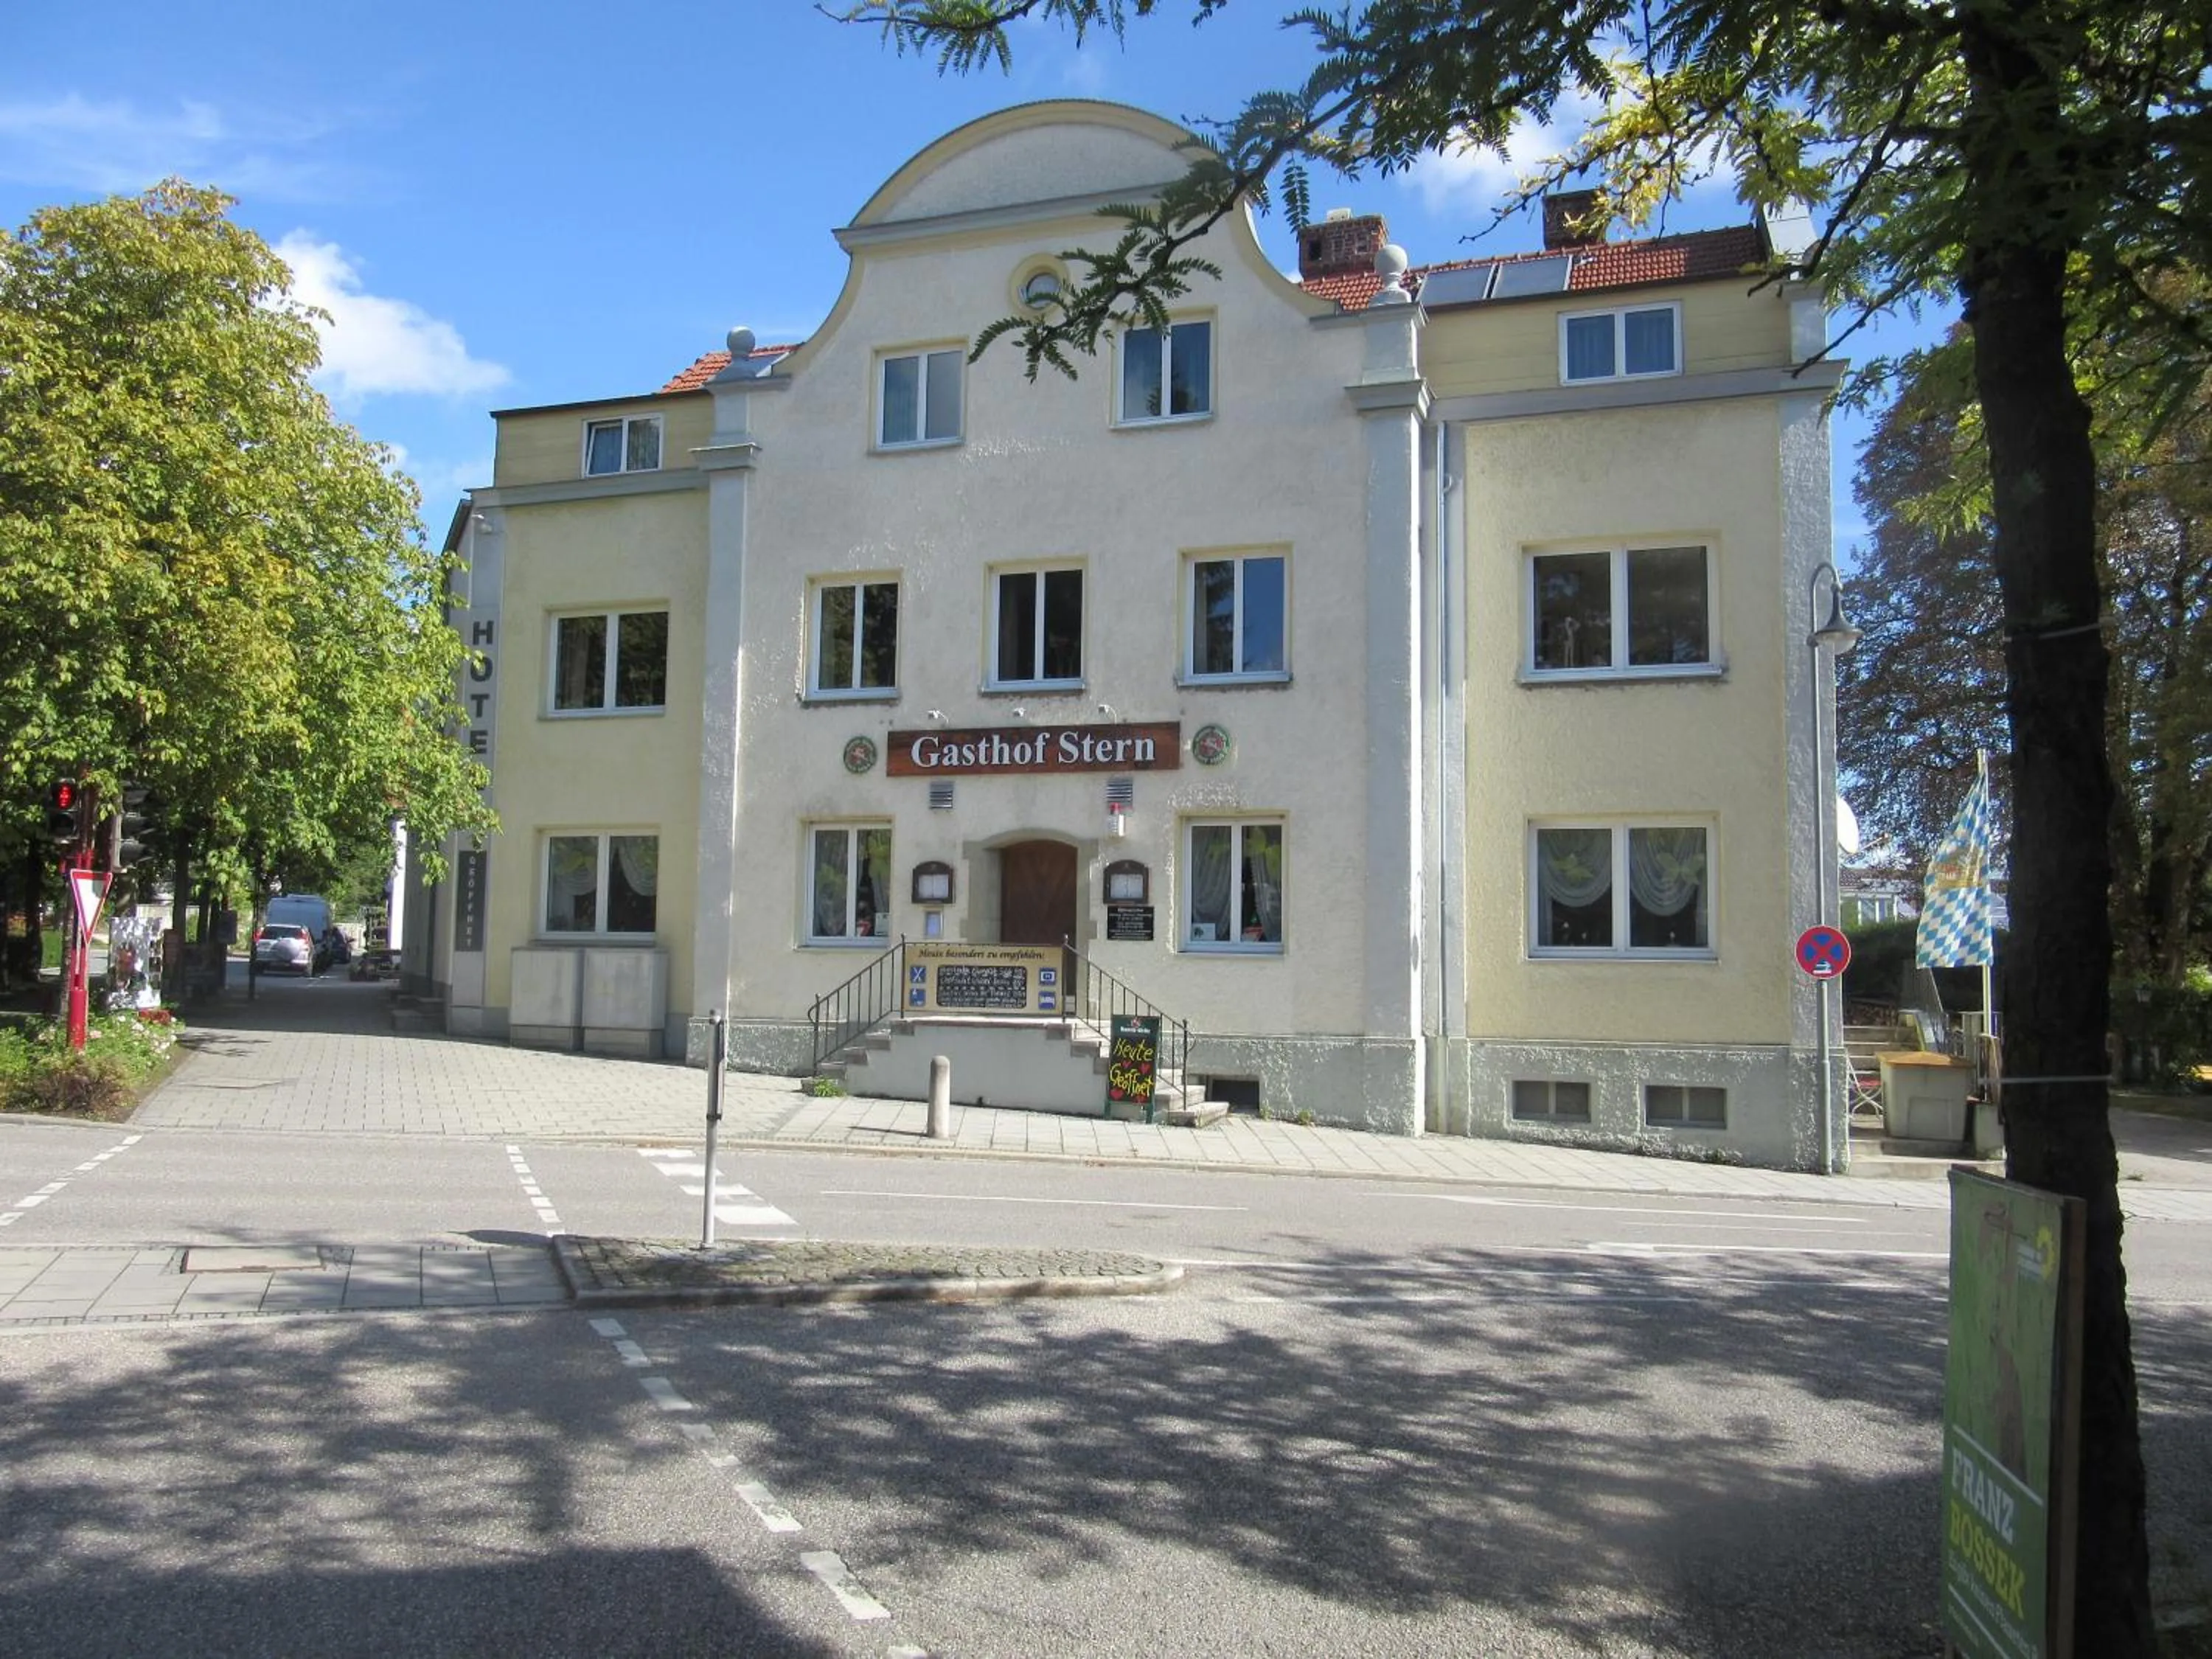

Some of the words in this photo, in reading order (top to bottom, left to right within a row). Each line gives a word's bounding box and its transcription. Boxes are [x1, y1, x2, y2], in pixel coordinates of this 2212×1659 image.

[470, 620, 494, 791] HOTE
[911, 733, 1050, 767] Gasthof
[1058, 731, 1155, 763] Stern
[1113, 1037, 1154, 1061] Heute
[1951, 1445, 2015, 1545] FRANZ
[1950, 1497, 2026, 1621] BOSSEK
